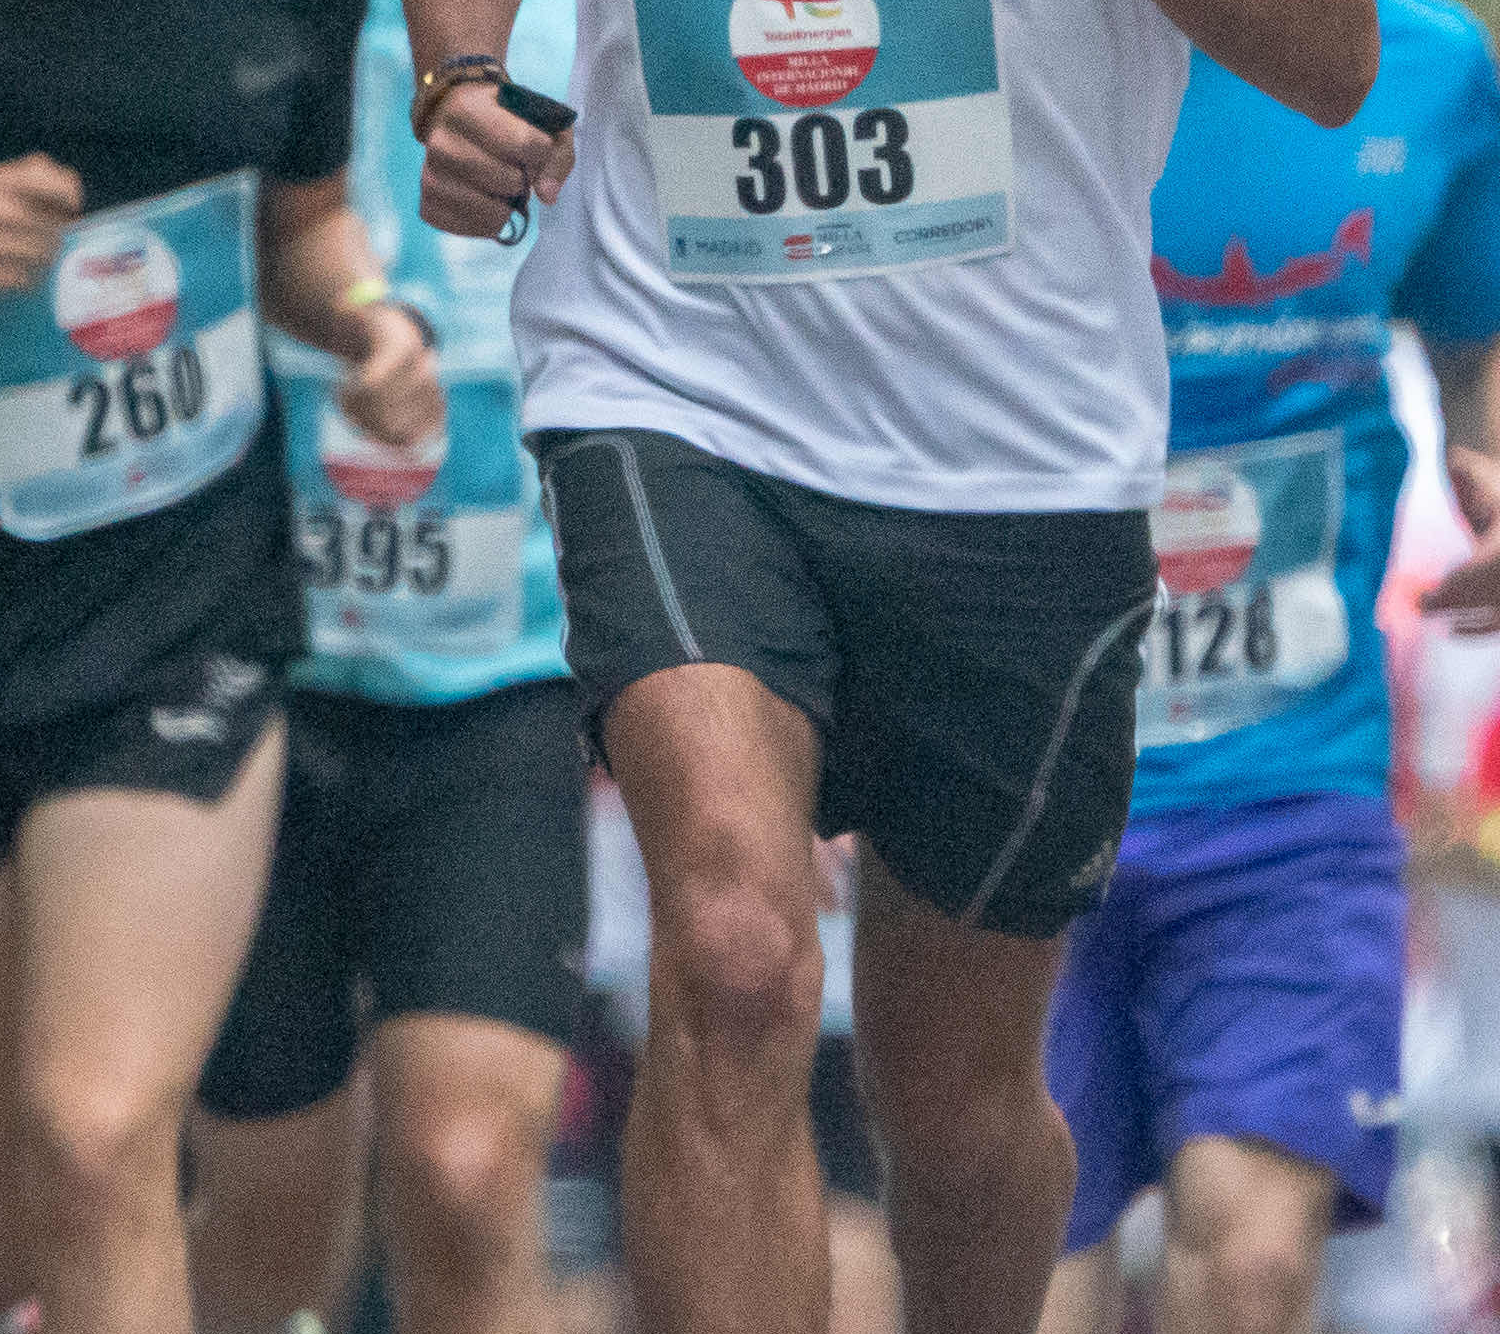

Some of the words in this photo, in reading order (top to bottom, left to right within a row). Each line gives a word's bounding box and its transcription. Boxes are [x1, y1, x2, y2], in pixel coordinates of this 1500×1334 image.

[763, 28, 853, 44] TotalEnergies
[732, 108, 914, 215] 303
[67, 347, 202, 462] 260
